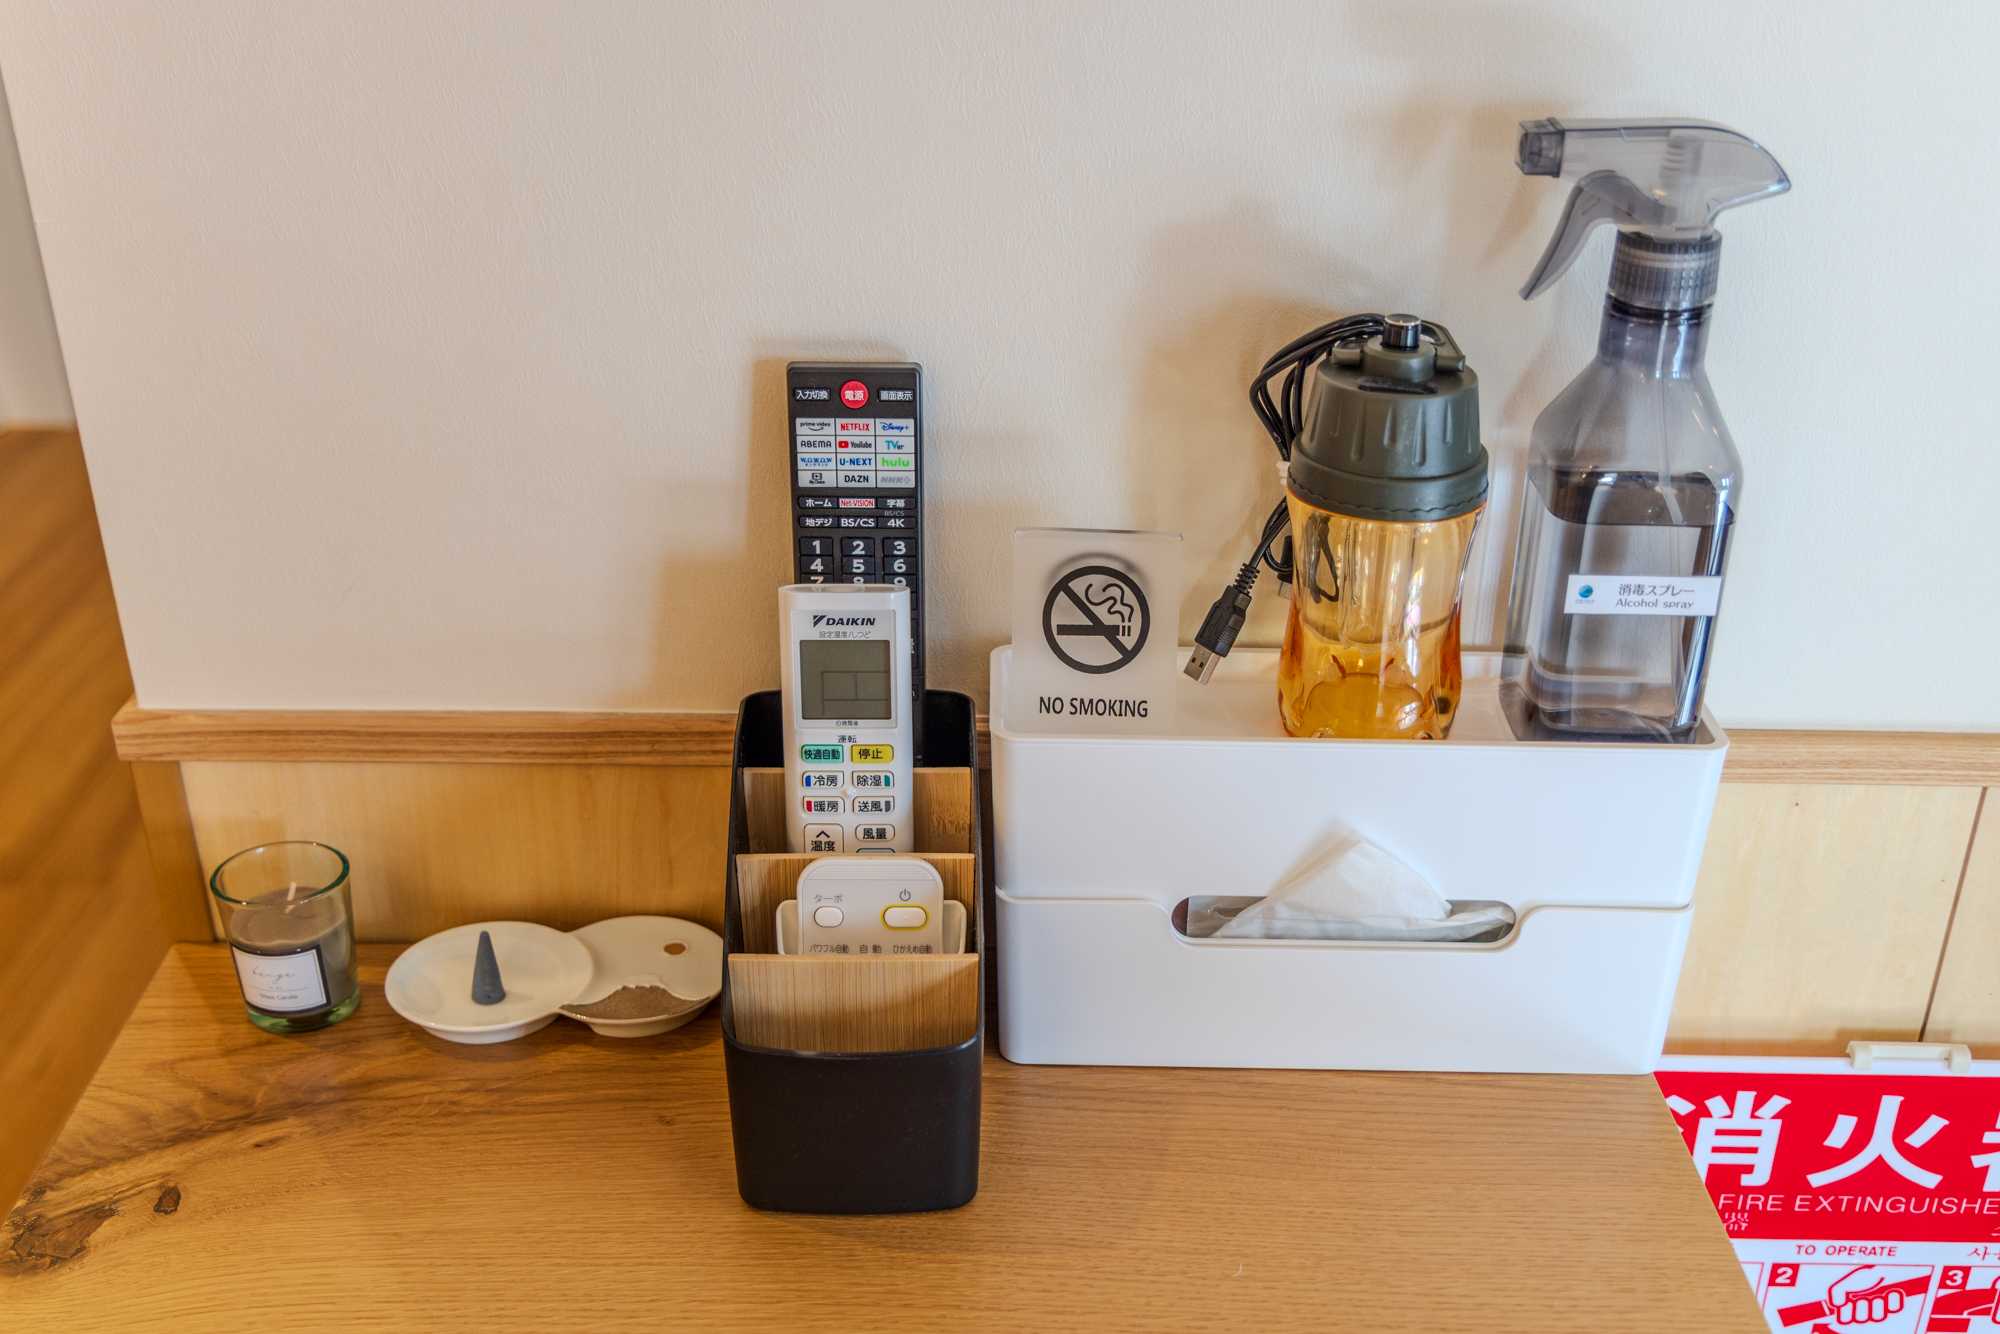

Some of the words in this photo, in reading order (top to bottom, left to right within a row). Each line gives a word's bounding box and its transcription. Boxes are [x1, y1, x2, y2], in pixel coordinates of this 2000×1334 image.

[844, 390, 864, 401] 電源
[840, 423, 870, 431] NETFLIX
[800, 440, 832, 448] ABEMA
[850, 441, 872, 449] YouTube
[885, 440, 904, 450] TVer
[839, 458, 872, 466] U-NEXT
[881, 457, 910, 467] hulu
[844, 475, 869, 483] DAZN
[806, 499, 832, 507] ホーム
[887, 499, 905, 508] 字幕
[841, 519, 875, 527] BS/CS
[887, 519, 904, 527] 4K
[812, 540, 821, 554] 1
[852, 541, 865, 555] 2
[893, 541, 906, 555] 3
[810, 558, 824, 572] 4
[852, 559, 865, 573] 5
[893, 559, 906, 573] 6
[1618, 583, 1695, 597] 消毒スプレー
[1615, 598, 1658, 608] Alcohol
[1662, 600, 1695, 609] spray
[825, 618, 876, 626] DAIKIN
[1039, 696, 1064, 715] NO
[1069, 697, 1149, 718] SMOKING
[804, 748, 840, 760] 快適自動
[859, 748, 882, 760] 停止
[813, 775, 838, 787] 冷房
[856, 775, 882, 787] 除湿
[814, 800, 839, 812] 暖房
[858, 800, 883, 812] 送風
[863, 828, 887, 839] 風量
[811, 840, 835, 852] 温度
[814, 894, 844, 903] ターボ
[1666, 1091, 2000, 1193] 消火
[1718, 1193, 1785, 1211] FIRE
[1793, 1194, 2000, 1215] EXTINGUISHE
[1796, 1244, 1816, 1256] TO
[1825, 1245, 1898, 1257] OPERATE
[1774, 1266, 1794, 1284] 2
[1945, 1269, 1965, 1287] 3
